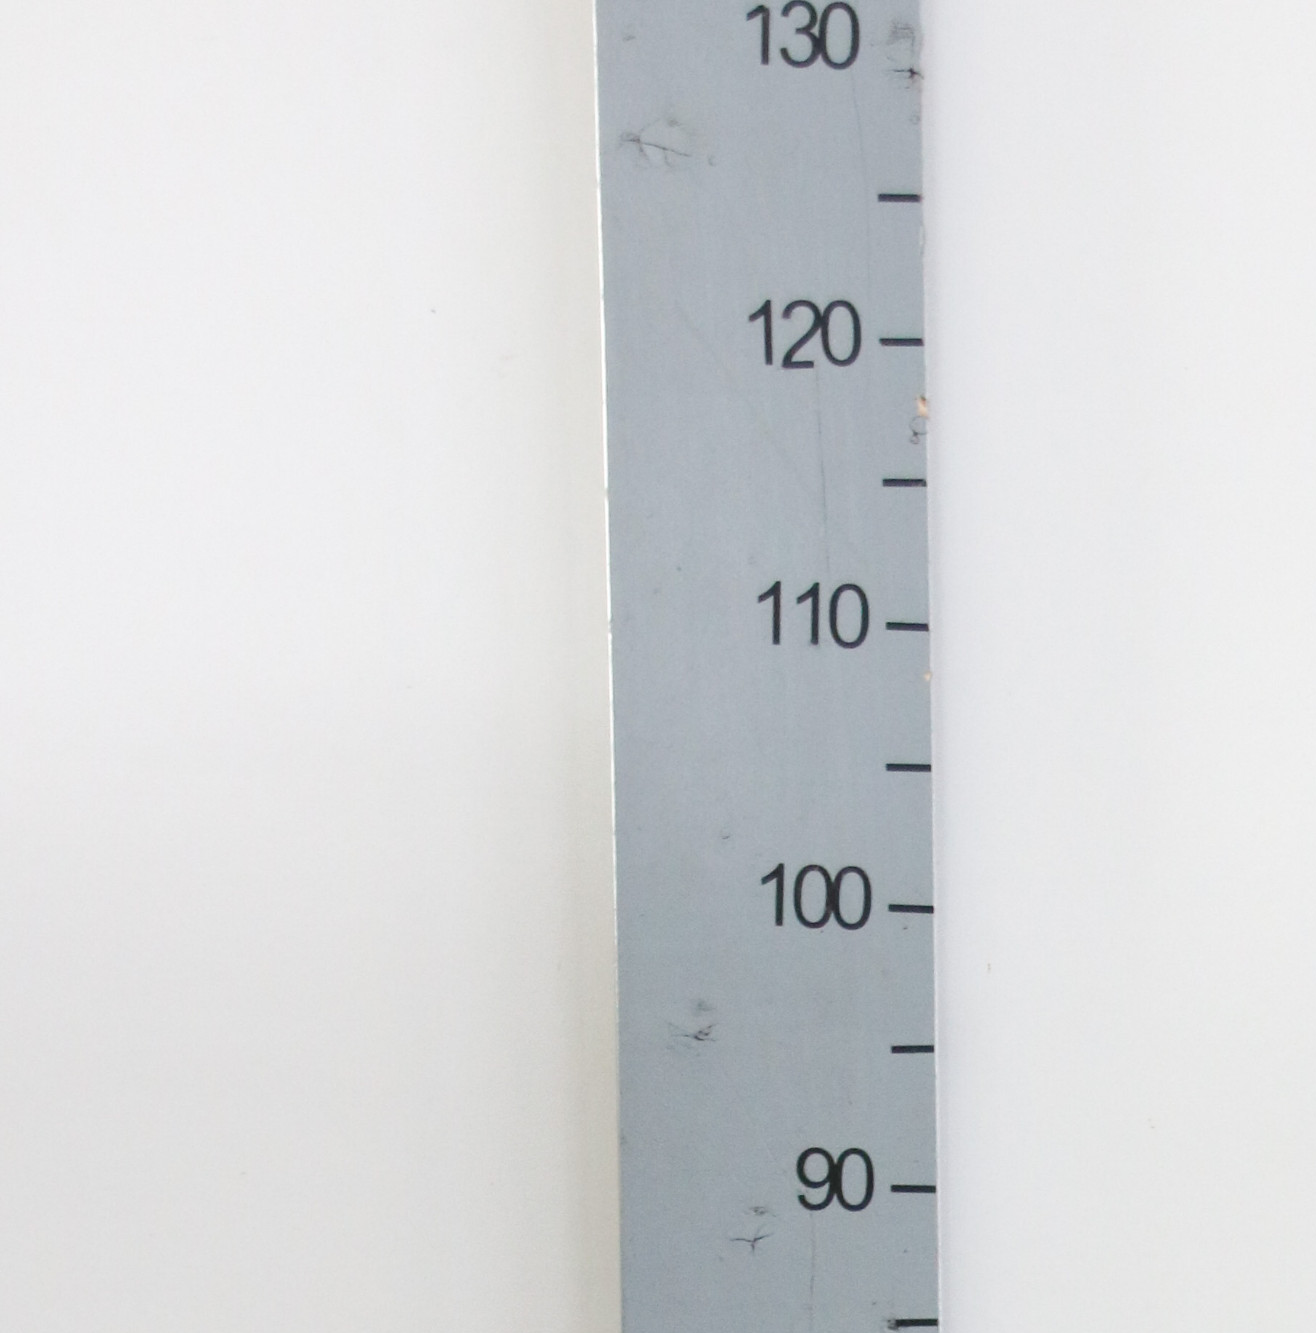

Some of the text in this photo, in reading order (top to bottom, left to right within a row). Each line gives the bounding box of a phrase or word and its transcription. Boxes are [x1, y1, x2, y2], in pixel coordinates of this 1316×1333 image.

[746, 1, 860, 69] 130
[748, 300, 862, 369] 120
[757, 580, 870, 649] 110
[761, 863, 872, 930] 100
[796, 1147, 874, 1212] 90
